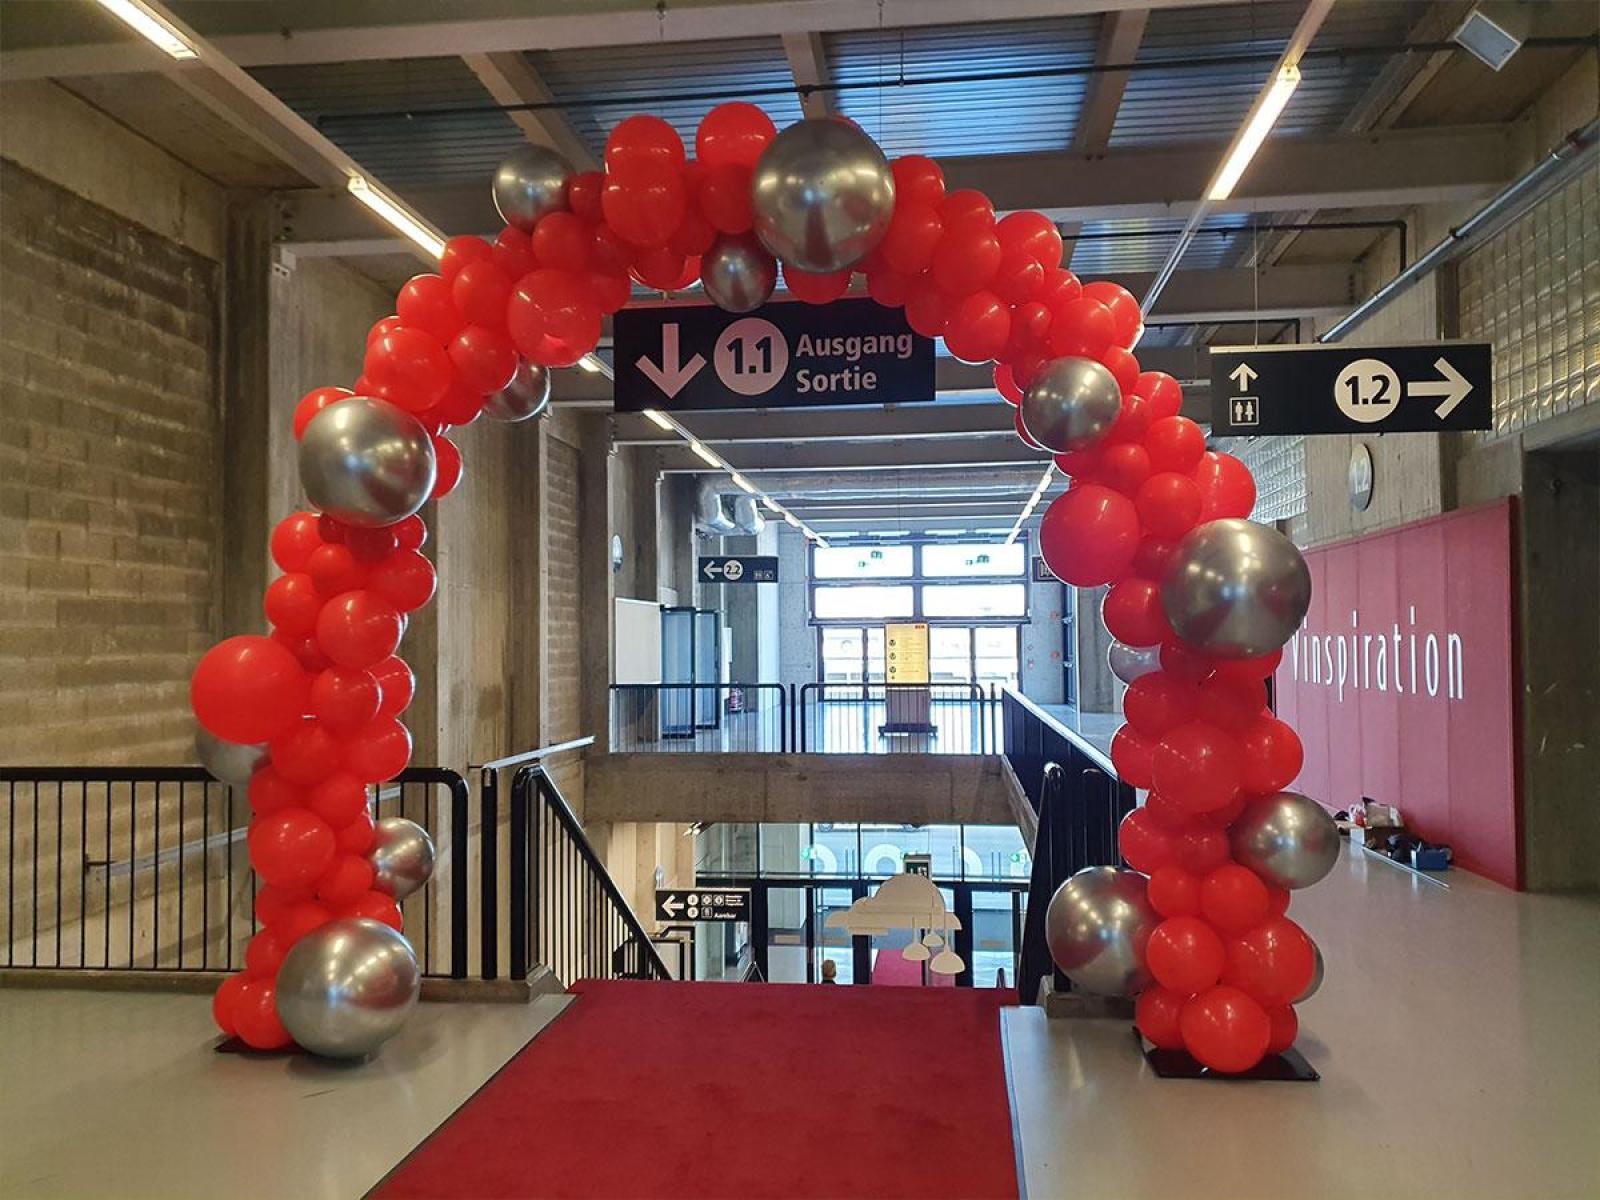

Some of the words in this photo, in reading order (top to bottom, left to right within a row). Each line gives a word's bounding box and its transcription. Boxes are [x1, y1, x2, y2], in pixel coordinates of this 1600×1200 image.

[727, 337, 772, 375] 1.1
[796, 333, 913, 359] Ausgang
[796, 365, 877, 393] Sortie
[1344, 374, 1391, 405] 1.2
